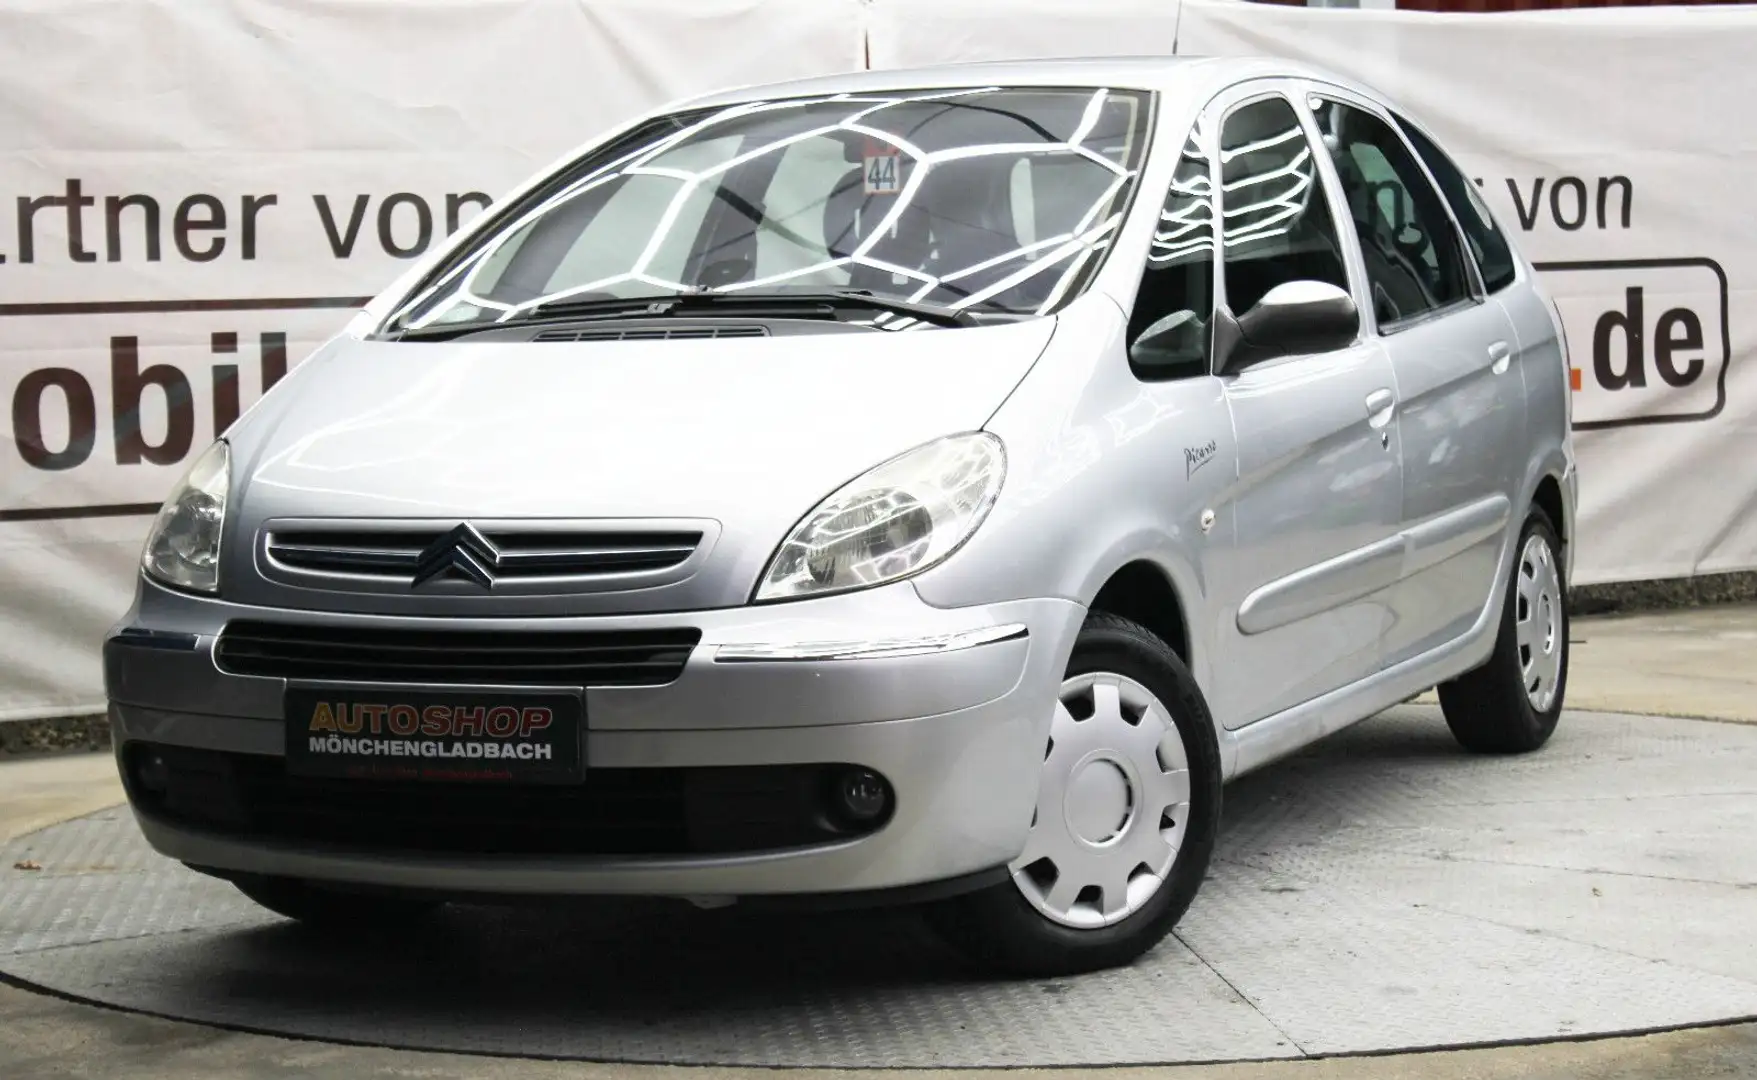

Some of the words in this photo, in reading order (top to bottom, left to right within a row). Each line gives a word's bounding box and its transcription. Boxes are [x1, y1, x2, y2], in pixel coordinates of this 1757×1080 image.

[867, 156, 896, 190] 44
[0, 178, 277, 264] rtner
[1505, 175, 1633, 231] von
[308, 701, 553, 737] AUTOSHOP
[308, 734, 552, 760] MÖNCHENGLADBACH
